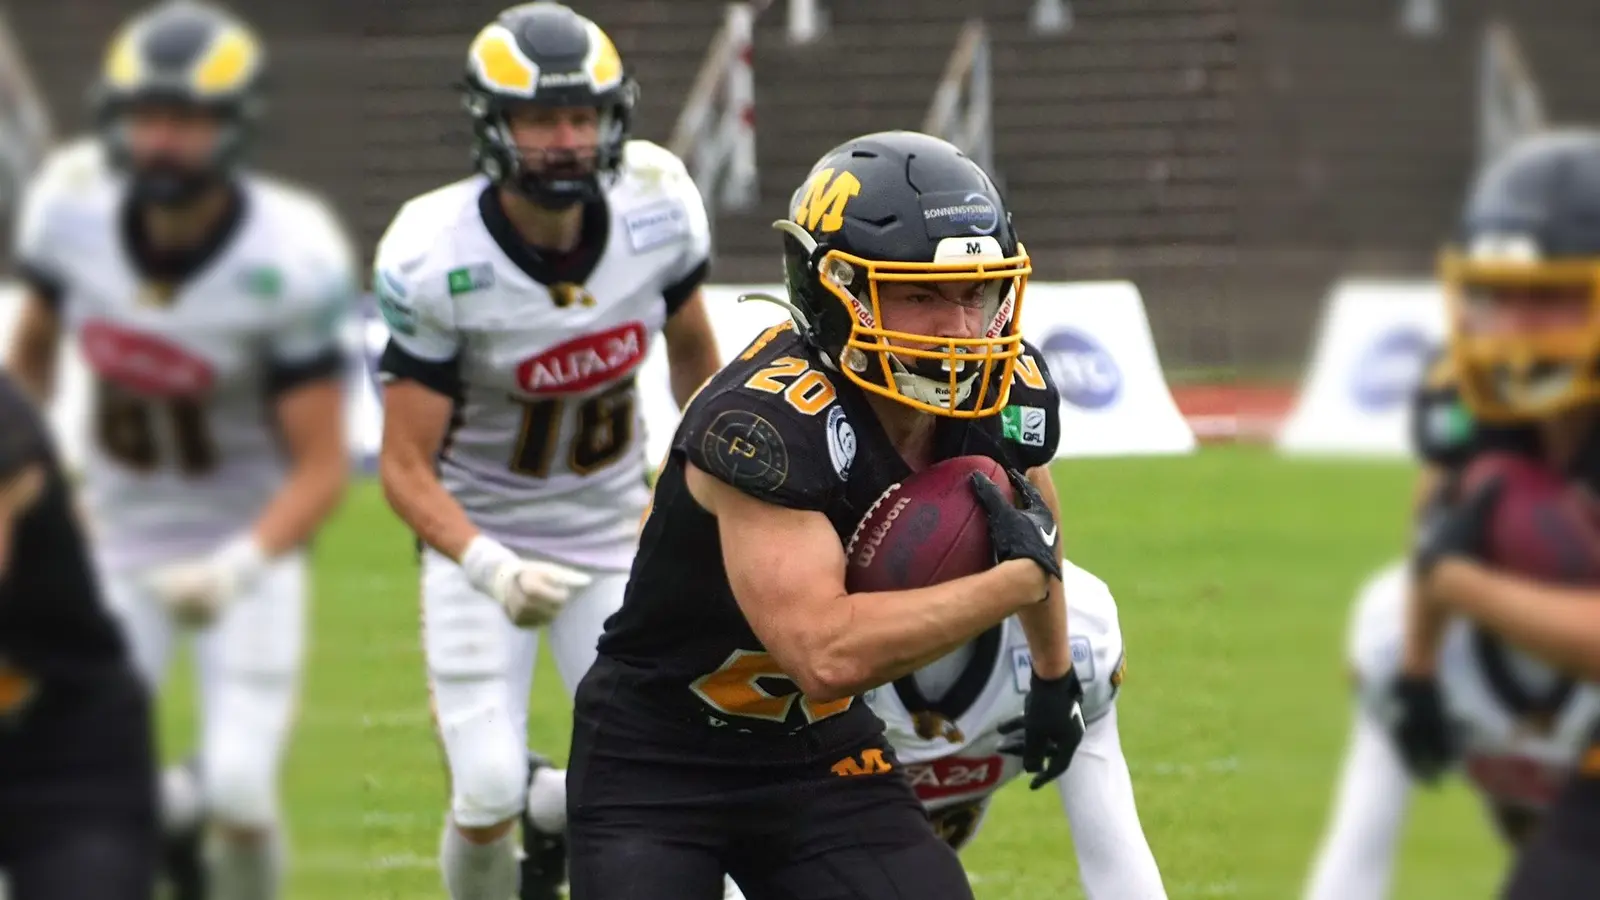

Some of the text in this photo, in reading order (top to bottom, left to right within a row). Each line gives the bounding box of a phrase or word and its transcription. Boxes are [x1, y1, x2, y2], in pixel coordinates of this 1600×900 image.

[796, 168, 861, 233] M
[966, 242, 982, 254] M
[744, 356, 838, 416] 20
